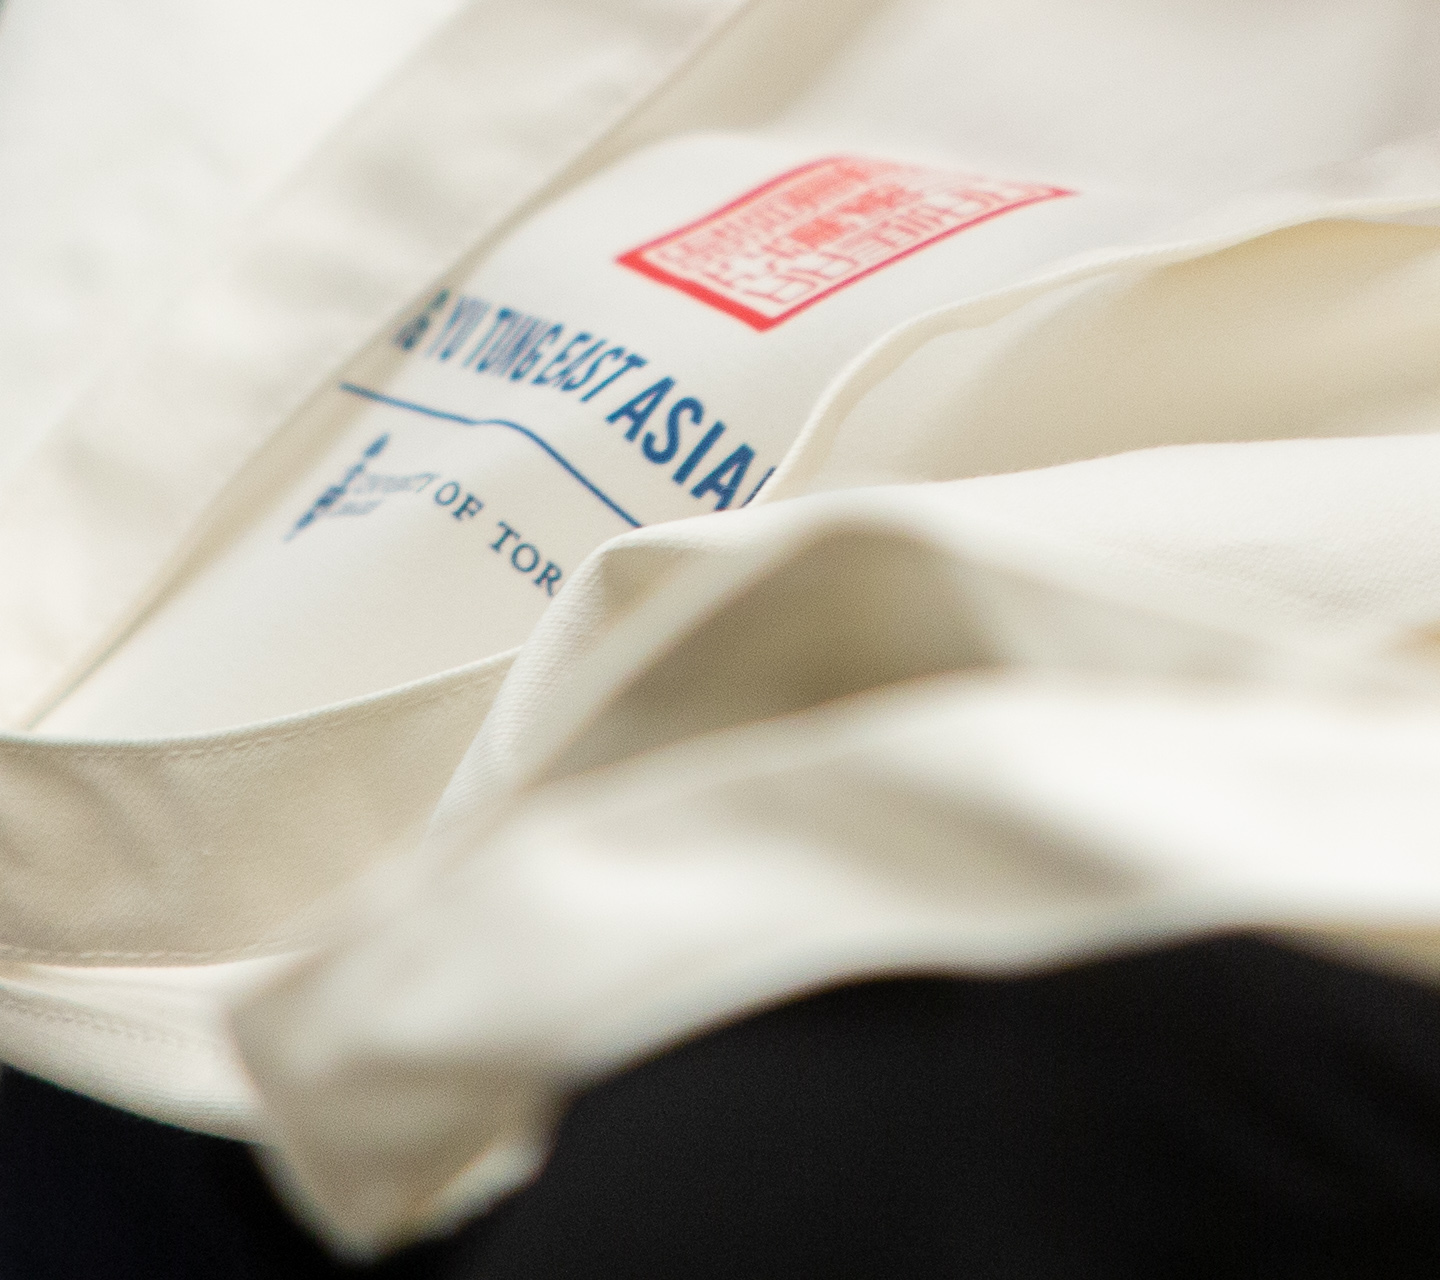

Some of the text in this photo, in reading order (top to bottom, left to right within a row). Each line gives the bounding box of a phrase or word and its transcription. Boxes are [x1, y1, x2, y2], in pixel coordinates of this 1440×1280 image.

[530, 330, 648, 404] EAST
[605, 375, 777, 512] ASIA
[433, 480, 485, 521] OF
